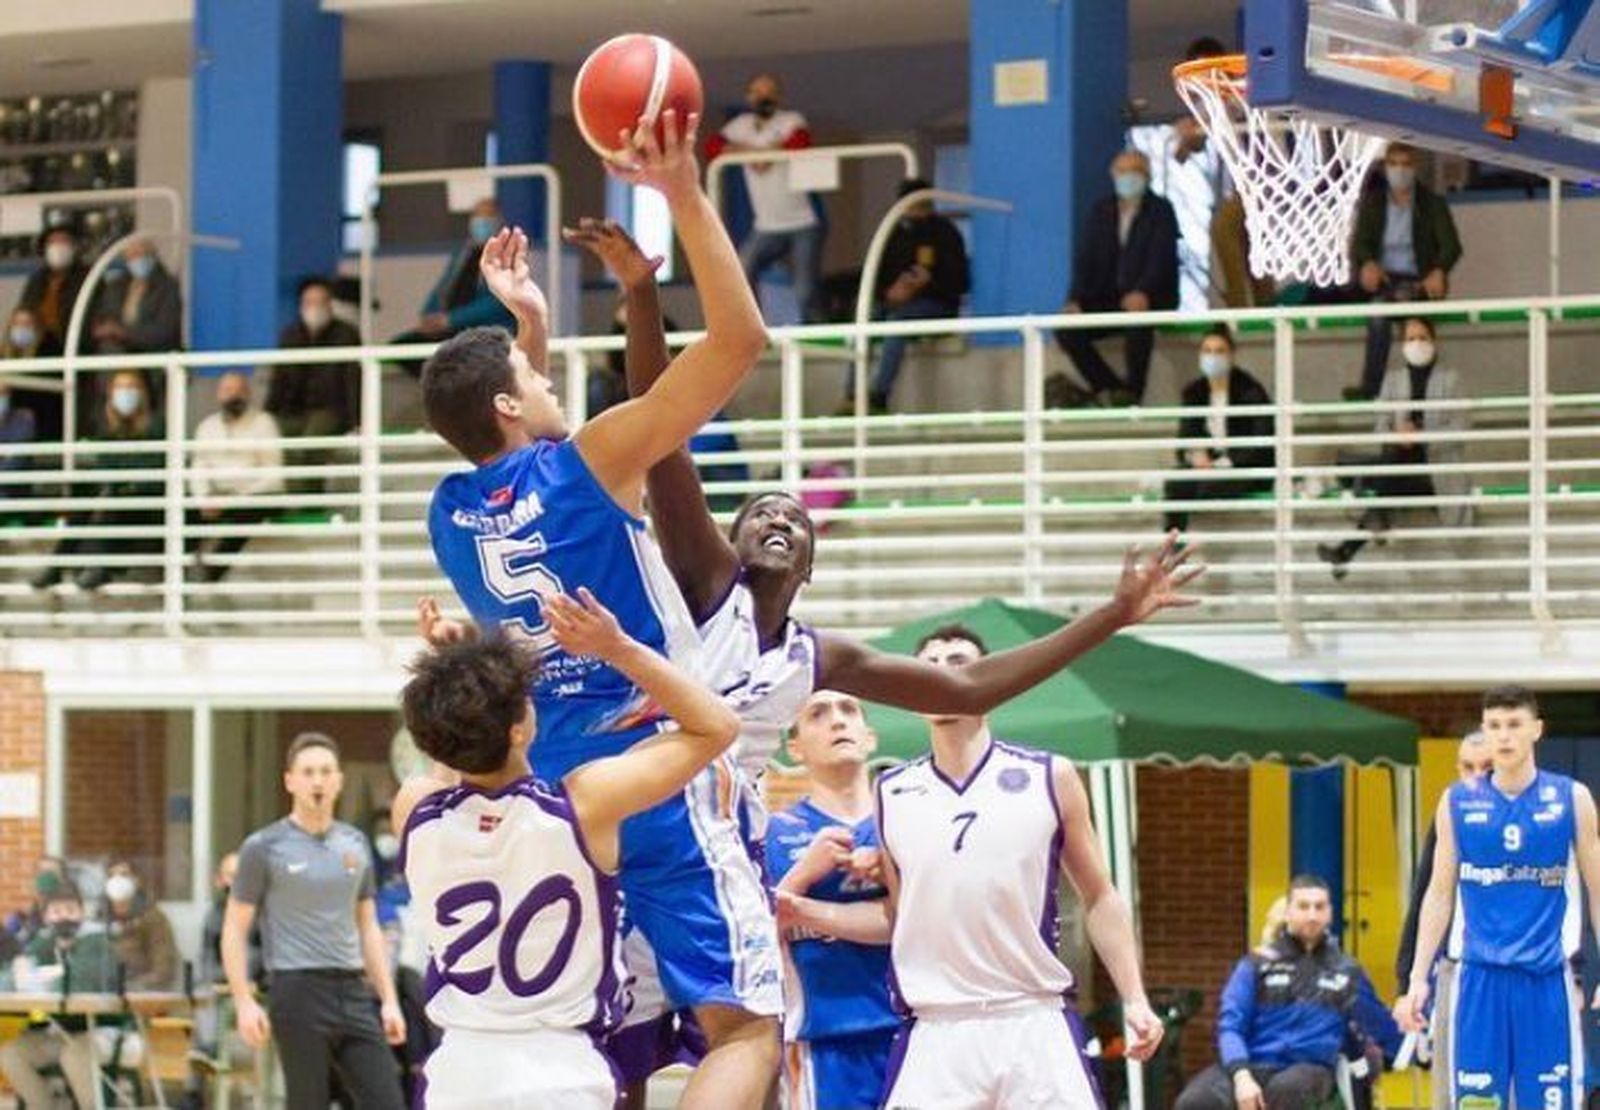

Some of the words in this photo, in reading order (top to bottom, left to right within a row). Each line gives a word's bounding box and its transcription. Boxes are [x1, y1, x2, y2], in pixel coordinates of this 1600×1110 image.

[474, 531, 565, 657] 5
[951, 811, 978, 852] 7
[1503, 823, 1521, 851] 9
[435, 873, 582, 997] 20
